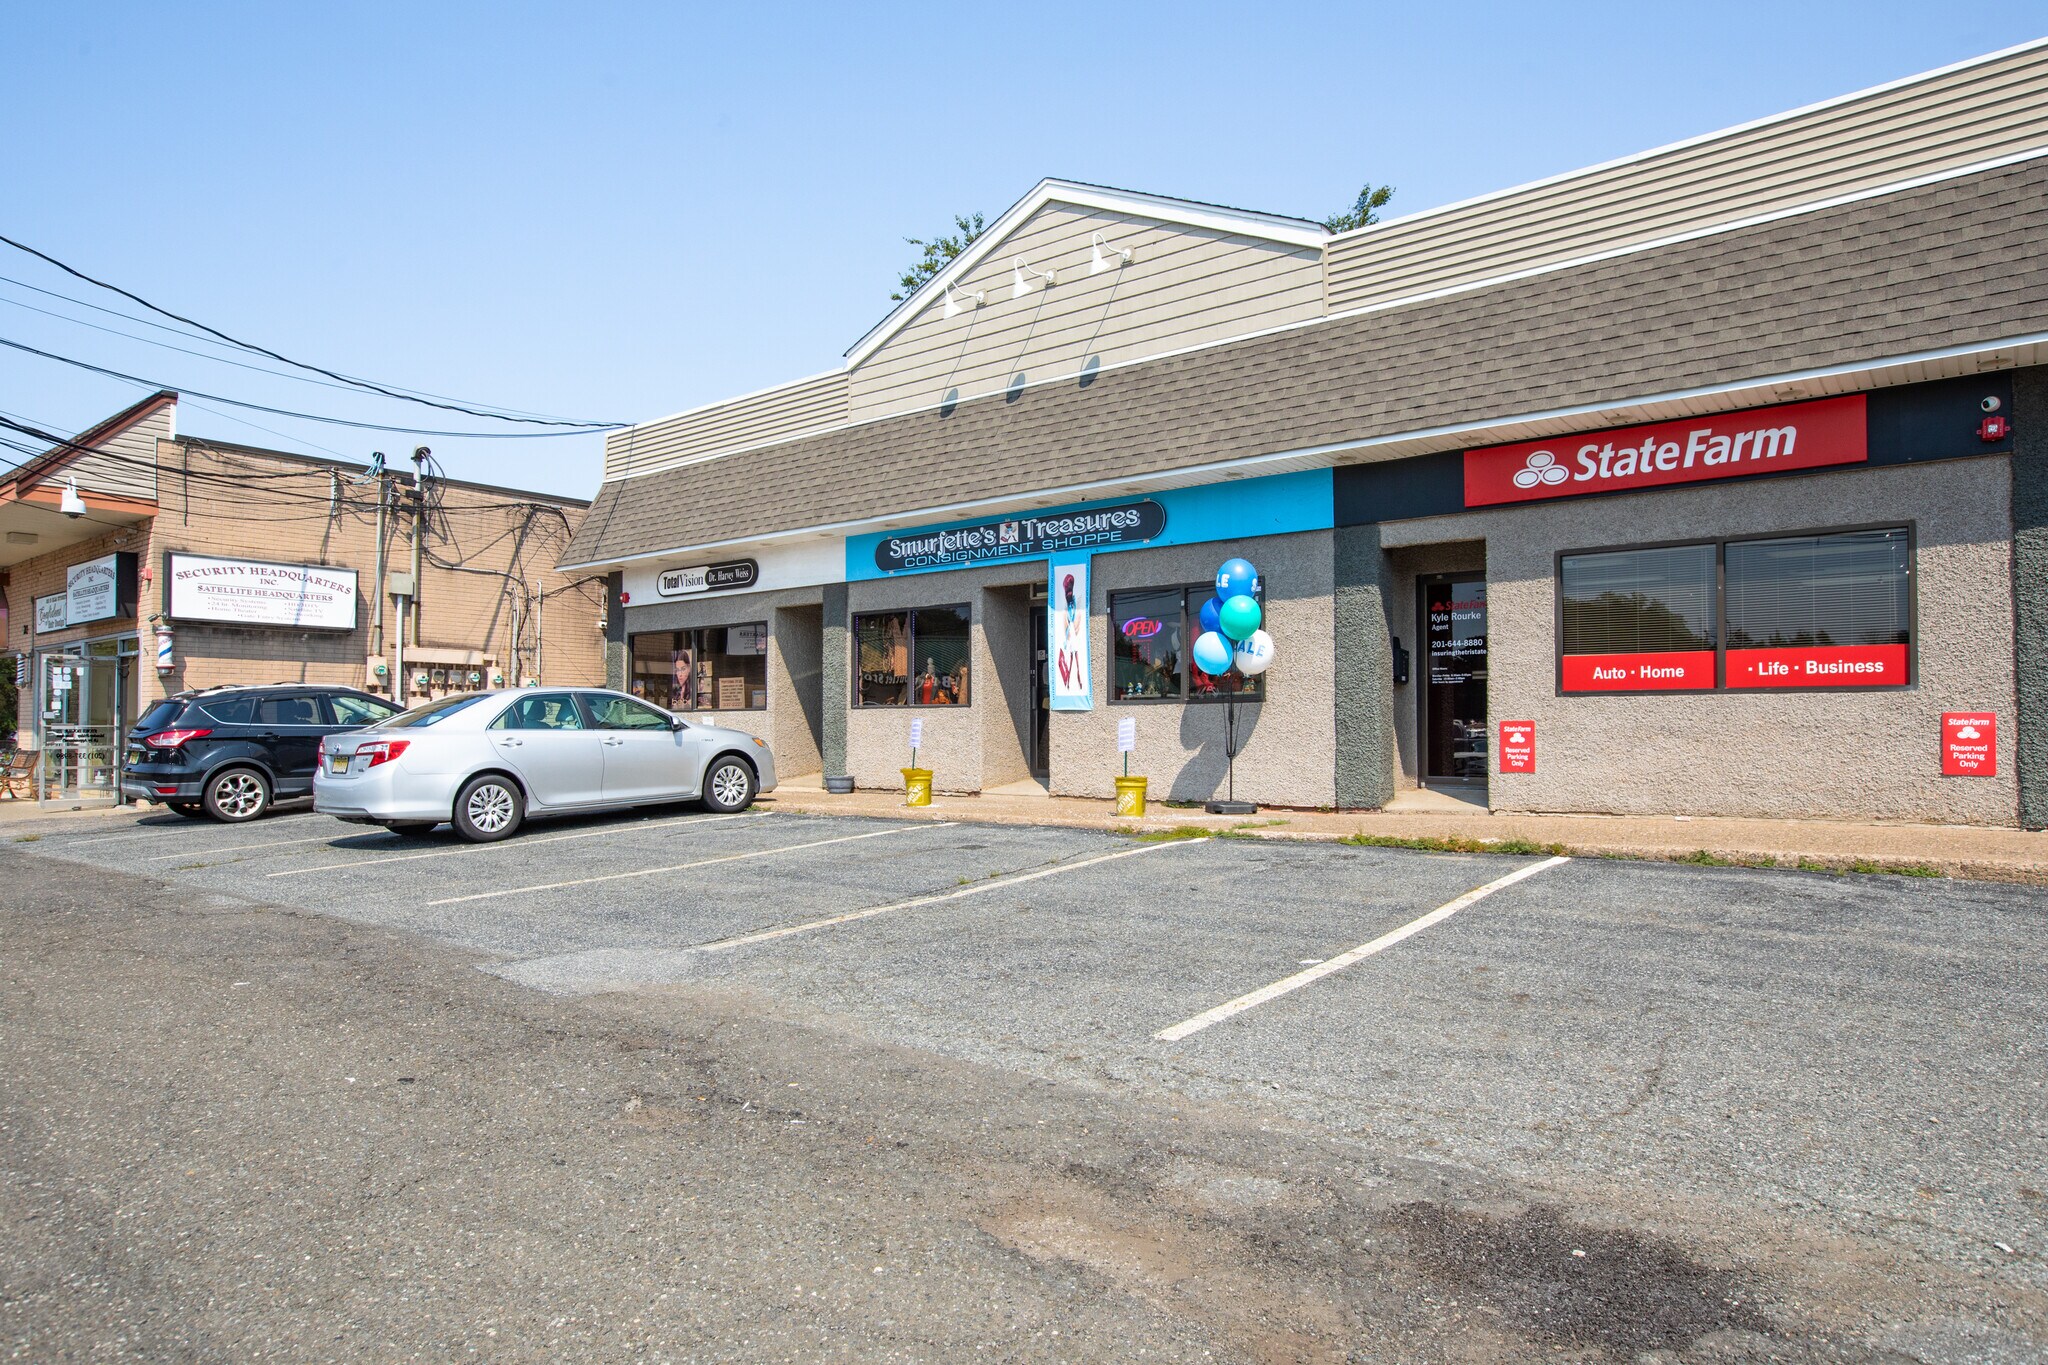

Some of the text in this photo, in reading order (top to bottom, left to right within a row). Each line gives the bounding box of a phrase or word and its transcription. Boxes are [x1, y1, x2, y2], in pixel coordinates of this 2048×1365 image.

[889, 509, 1141, 559] Smurfette's Treasures
[904, 530, 1122, 568] CONSIGNMENT SHOPPE
[175, 566, 352, 595] SECURITY HEADQUARTERS
[197, 585, 334, 601] SATELLITE HEADQUARTERS
[1431, 611, 1481, 623] Kyle Rourke
[1125, 620, 1159, 637] OPEN
[1235, 640, 1266, 658] ALE
[1592, 665, 1685, 680] Auto Home
[1758, 659, 1884, 676] Life Business
[1950, 744, 1988, 752] Reserved
[1507, 753, 1529, 761] Parking
[1953, 752, 1985, 761] Parking
[1959, 760, 1979, 769] Only
